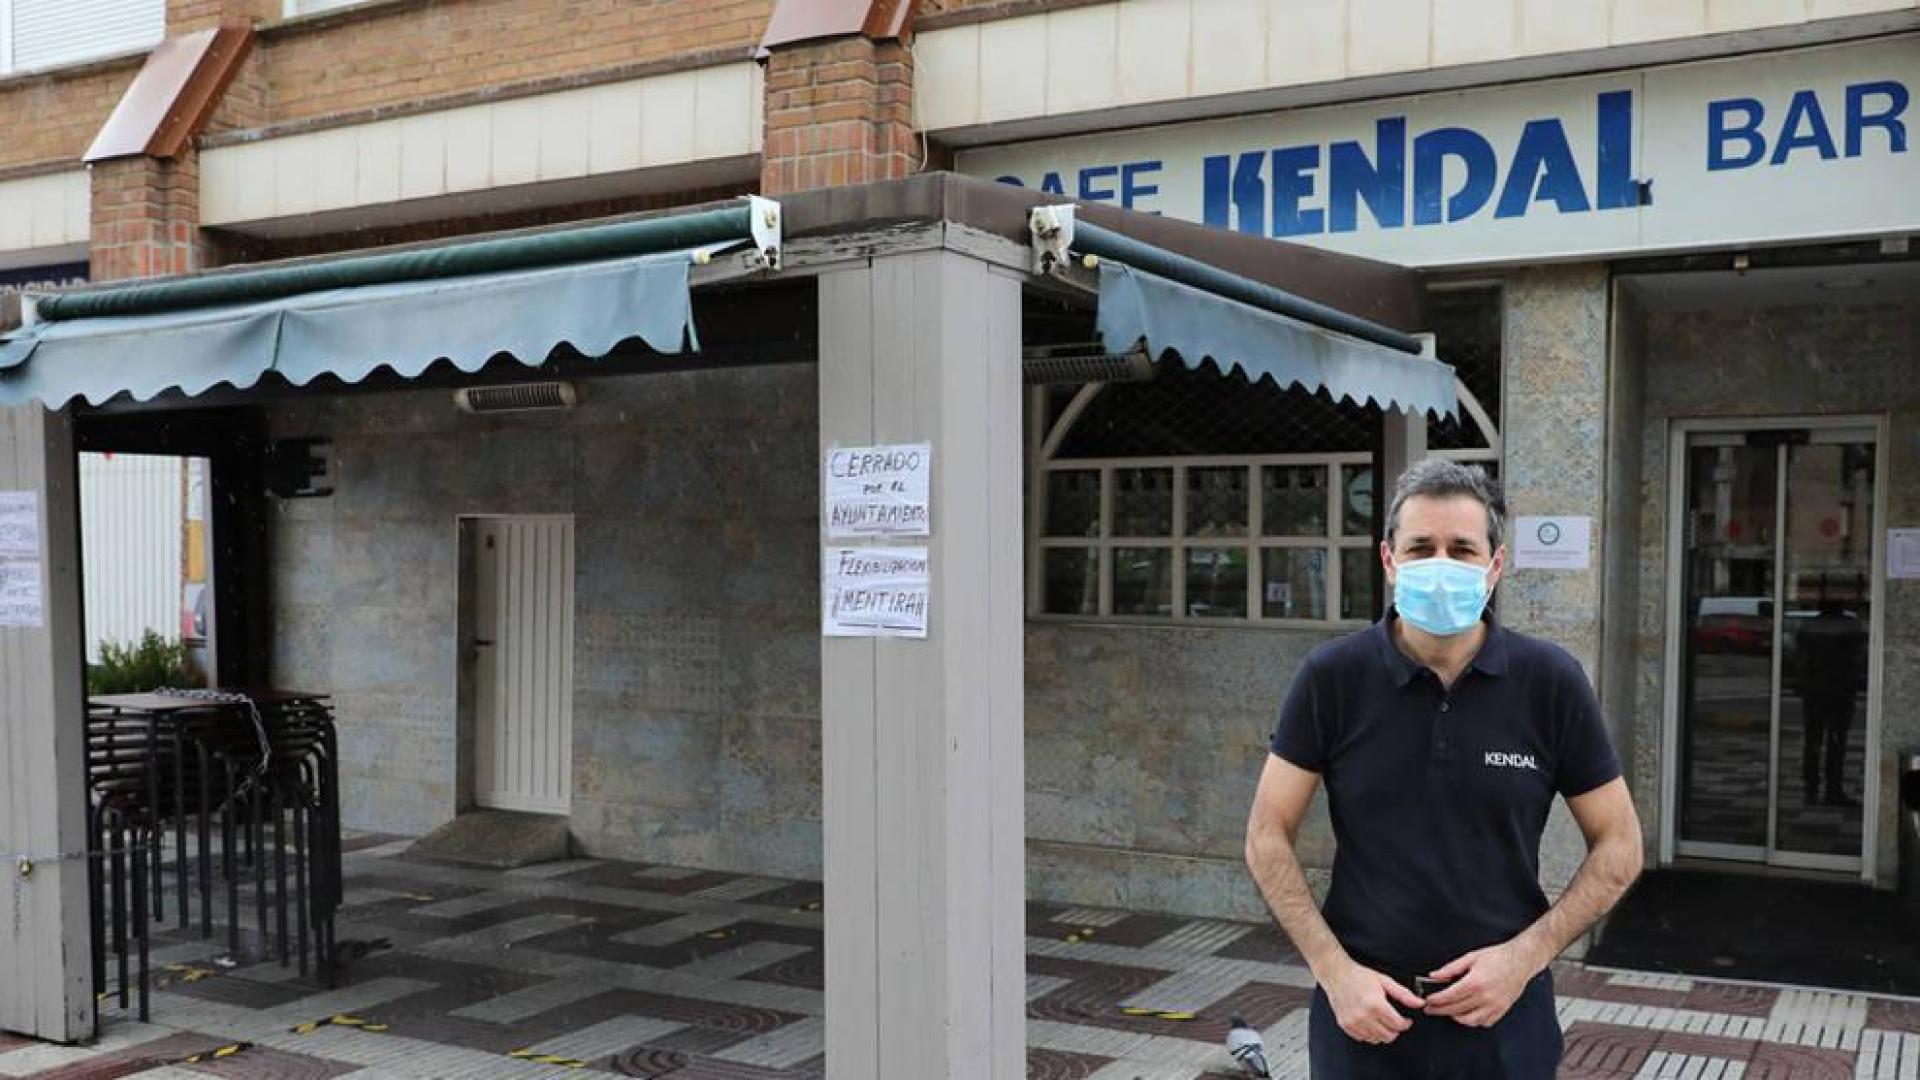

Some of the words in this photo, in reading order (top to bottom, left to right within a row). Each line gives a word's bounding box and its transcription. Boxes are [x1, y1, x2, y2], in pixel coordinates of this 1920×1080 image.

[1203, 90, 1652, 237] KENDAL
[1707, 80, 1909, 171] BAR
[831, 450, 920, 478] CERRADO
[1485, 751, 1537, 769] KENDAL
